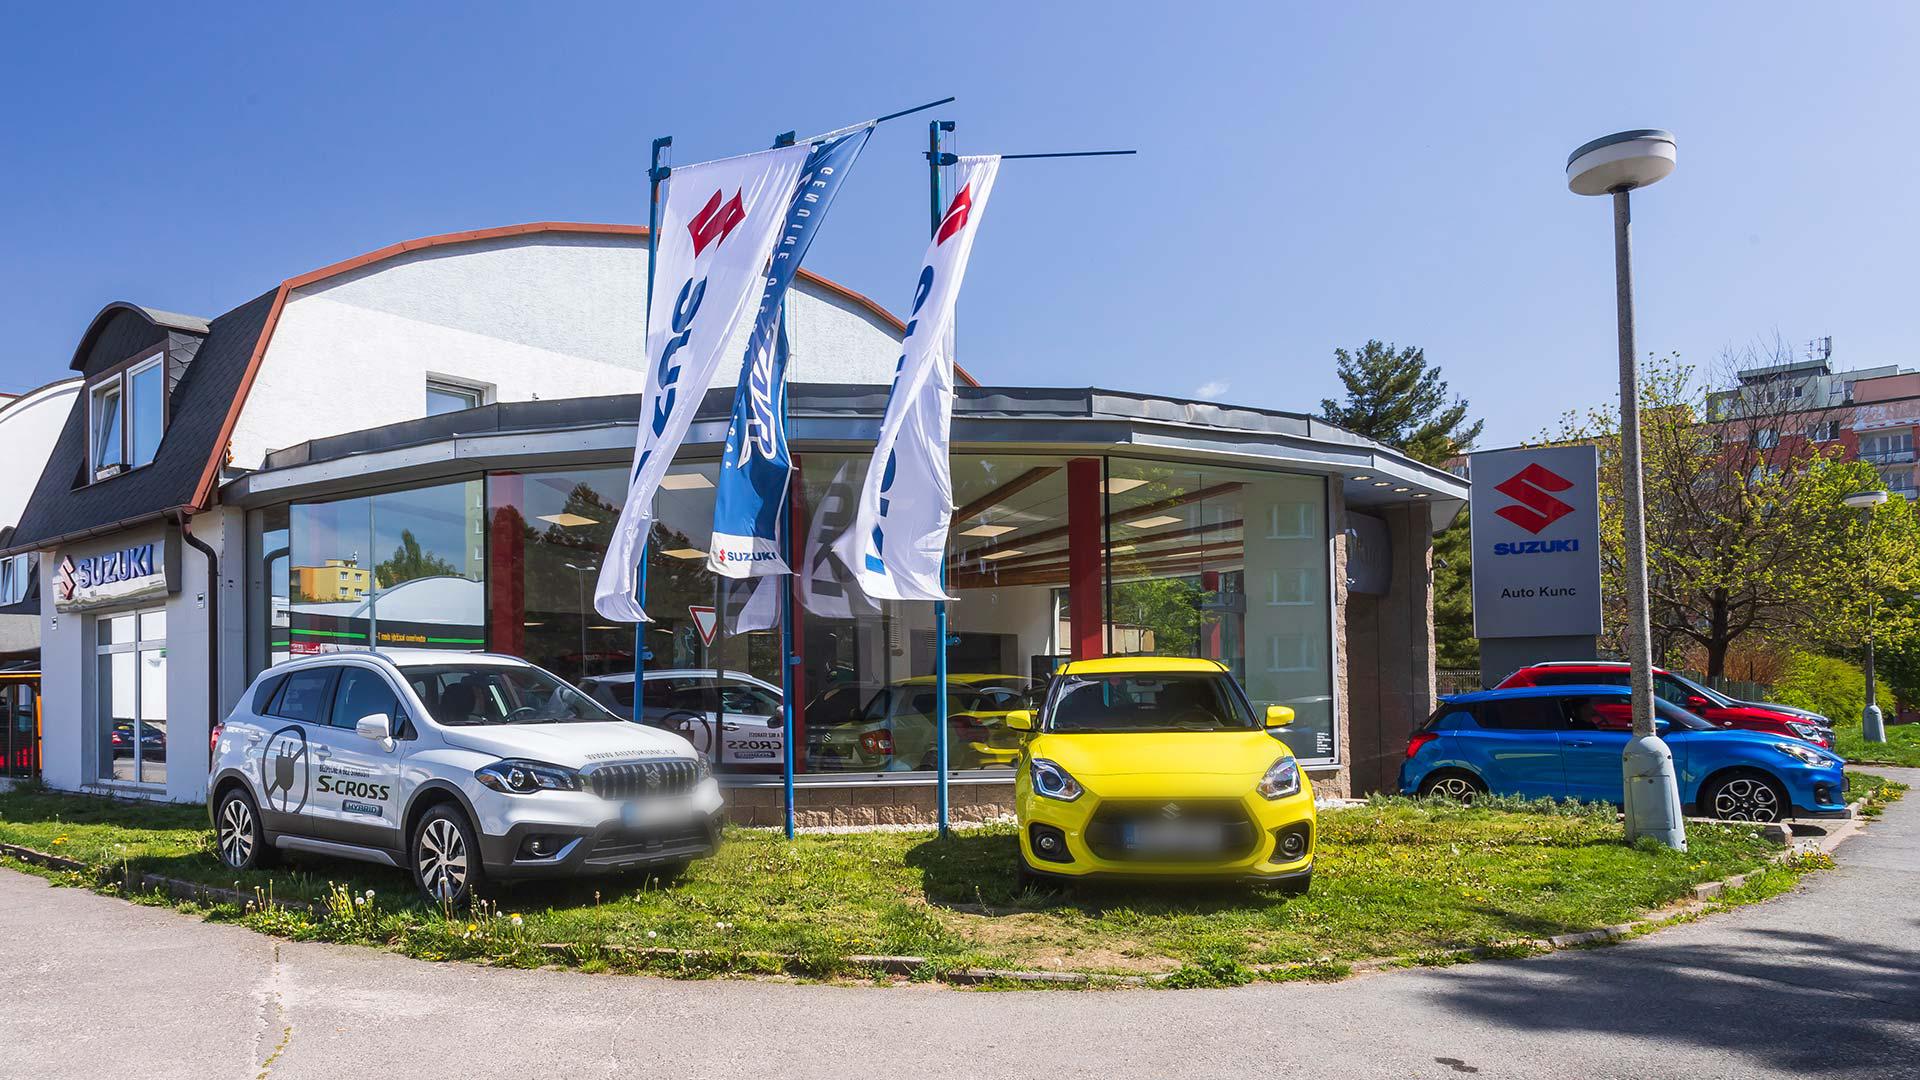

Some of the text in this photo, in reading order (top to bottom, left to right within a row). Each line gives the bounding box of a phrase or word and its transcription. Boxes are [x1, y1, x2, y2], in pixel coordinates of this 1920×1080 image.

[778, 166, 834, 260] GENUINE
[1494, 539, 1579, 556] SUZUKI
[727, 551, 777, 562] SUZUKI
[79, 544, 154, 589] SUZUKI
[1501, 586, 1576, 599] Auto Kunc
[348, 803, 377, 814] HYBRID
